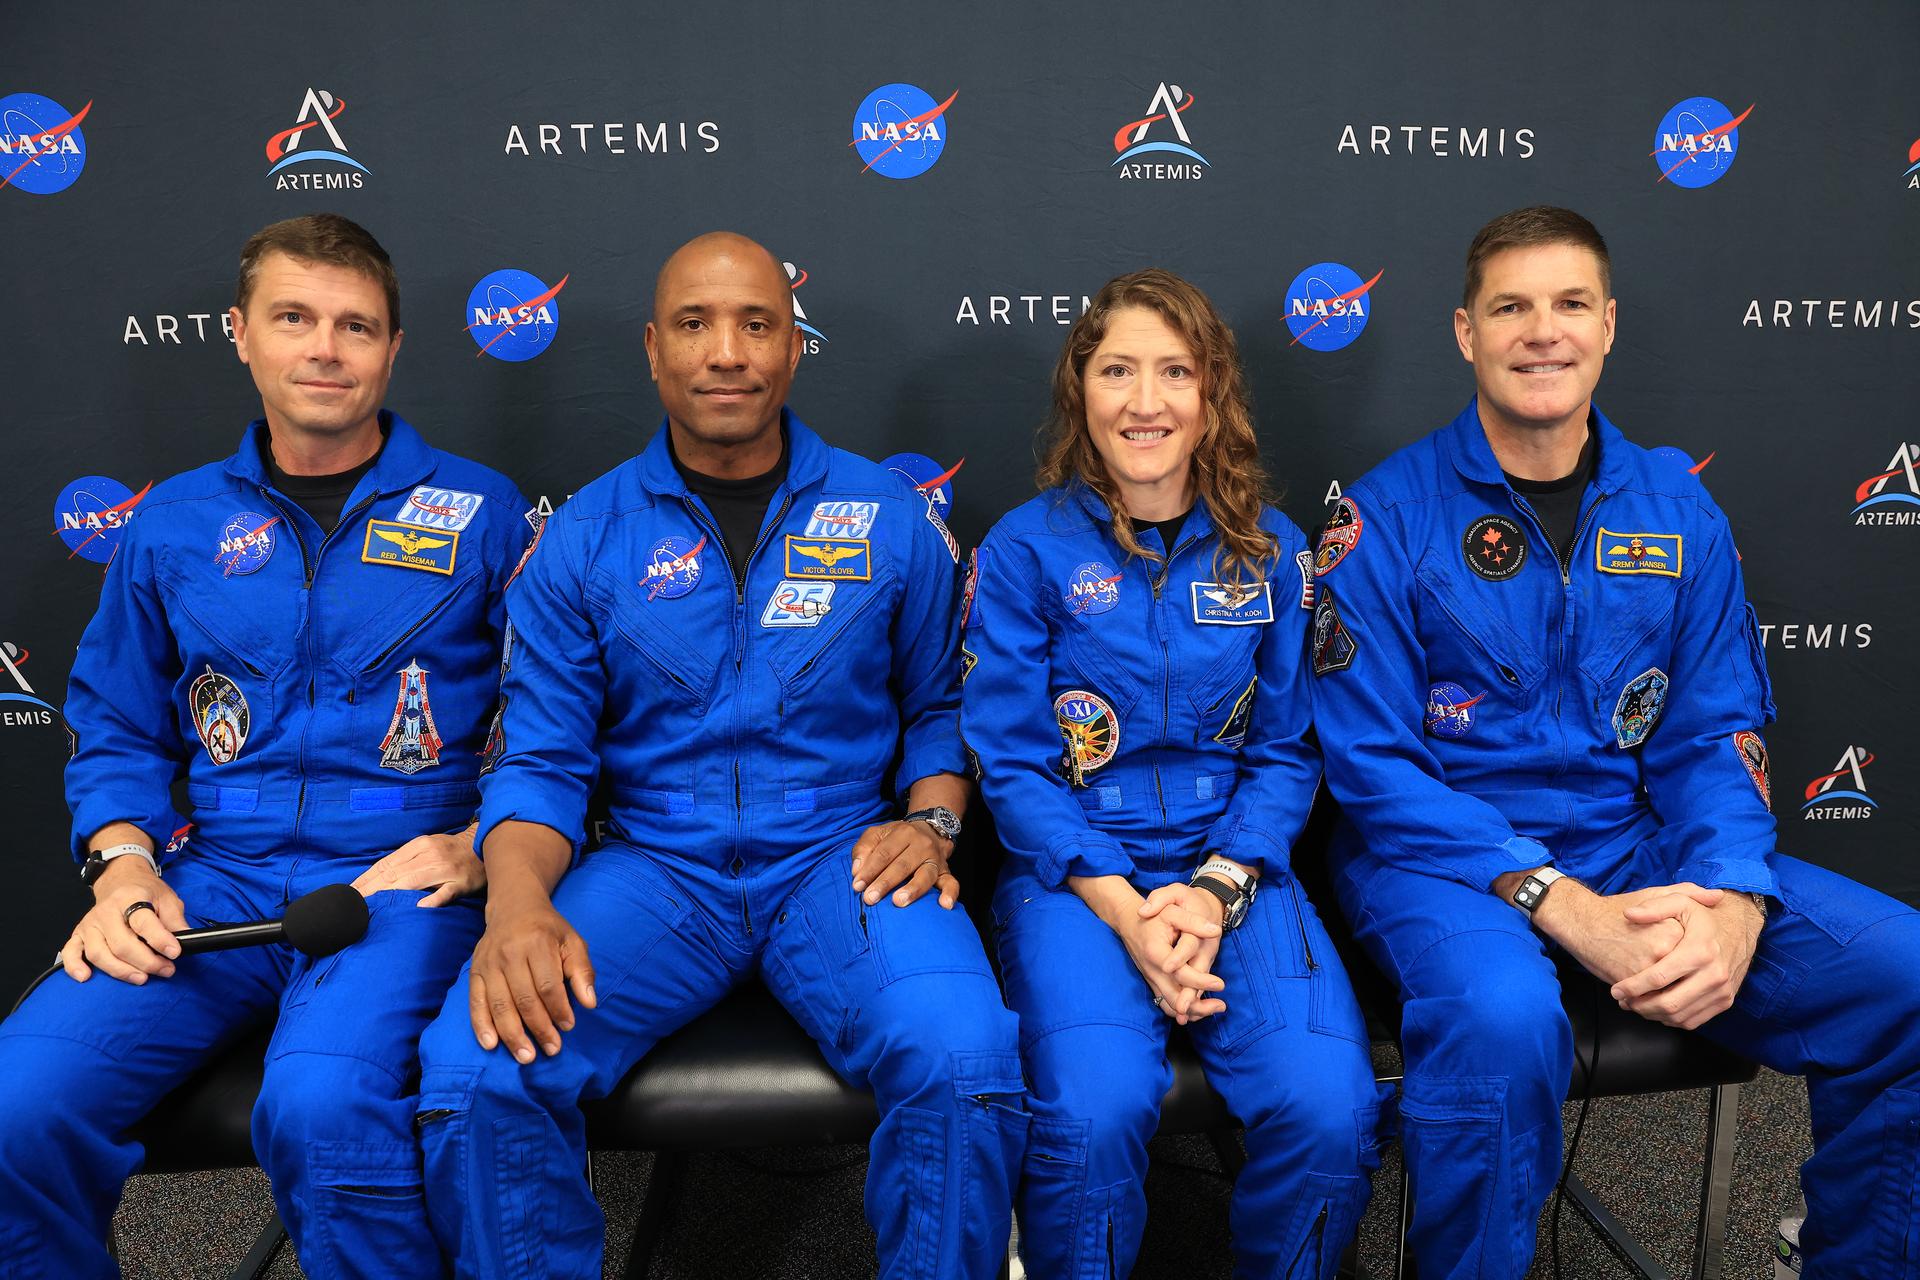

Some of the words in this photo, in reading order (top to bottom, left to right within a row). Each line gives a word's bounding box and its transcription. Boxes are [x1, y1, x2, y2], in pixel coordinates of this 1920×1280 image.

[505, 122, 720, 155] ARTEMIS
[861, 121, 941, 141] NASA
[0, 134, 81, 155] NASA
[1338, 125, 1535, 158] ARTEMIS
[1661, 133, 1733, 153] NASA
[1119, 163, 1202, 180] ARTEMIS
[276, 173, 362, 190] ARTEMIS
[474, 305, 554, 326] NASA
[956, 295, 1091, 325] ARTE
[1292, 298, 1365, 317] NASA
[1743, 299, 1920, 329] ARTEMIS
[123, 313, 236, 345] ARTE
[1855, 511, 1920, 526] ARTEMIS
[1466, 521, 1483, 544] CANADIAN
[1500, 519, 1519, 534] AGENCY
[220, 531, 271, 554] NASA
[380, 551, 397, 560] REID
[401, 553, 436, 567] WISEMAN
[647, 557, 700, 578] NASA
[1468, 554, 1484, 572] AGENCE
[1611, 560, 1636, 568] JEREMY
[1639, 560, 1667, 570] HANSEN
[803, 566, 826, 574] VICTOR
[829, 567, 855, 575] GLOVER
[1072, 581, 1118, 597] NASA
[1204, 609, 1233, 617] CHRISTINA
[1244, 609, 1263, 617] KOCH
[1759, 623, 1873, 649] TEMIS
[0, 710, 52, 726] EMIS
[1063, 701, 1091, 718] LXI
[1805, 806, 1871, 820] ARTEMIS
